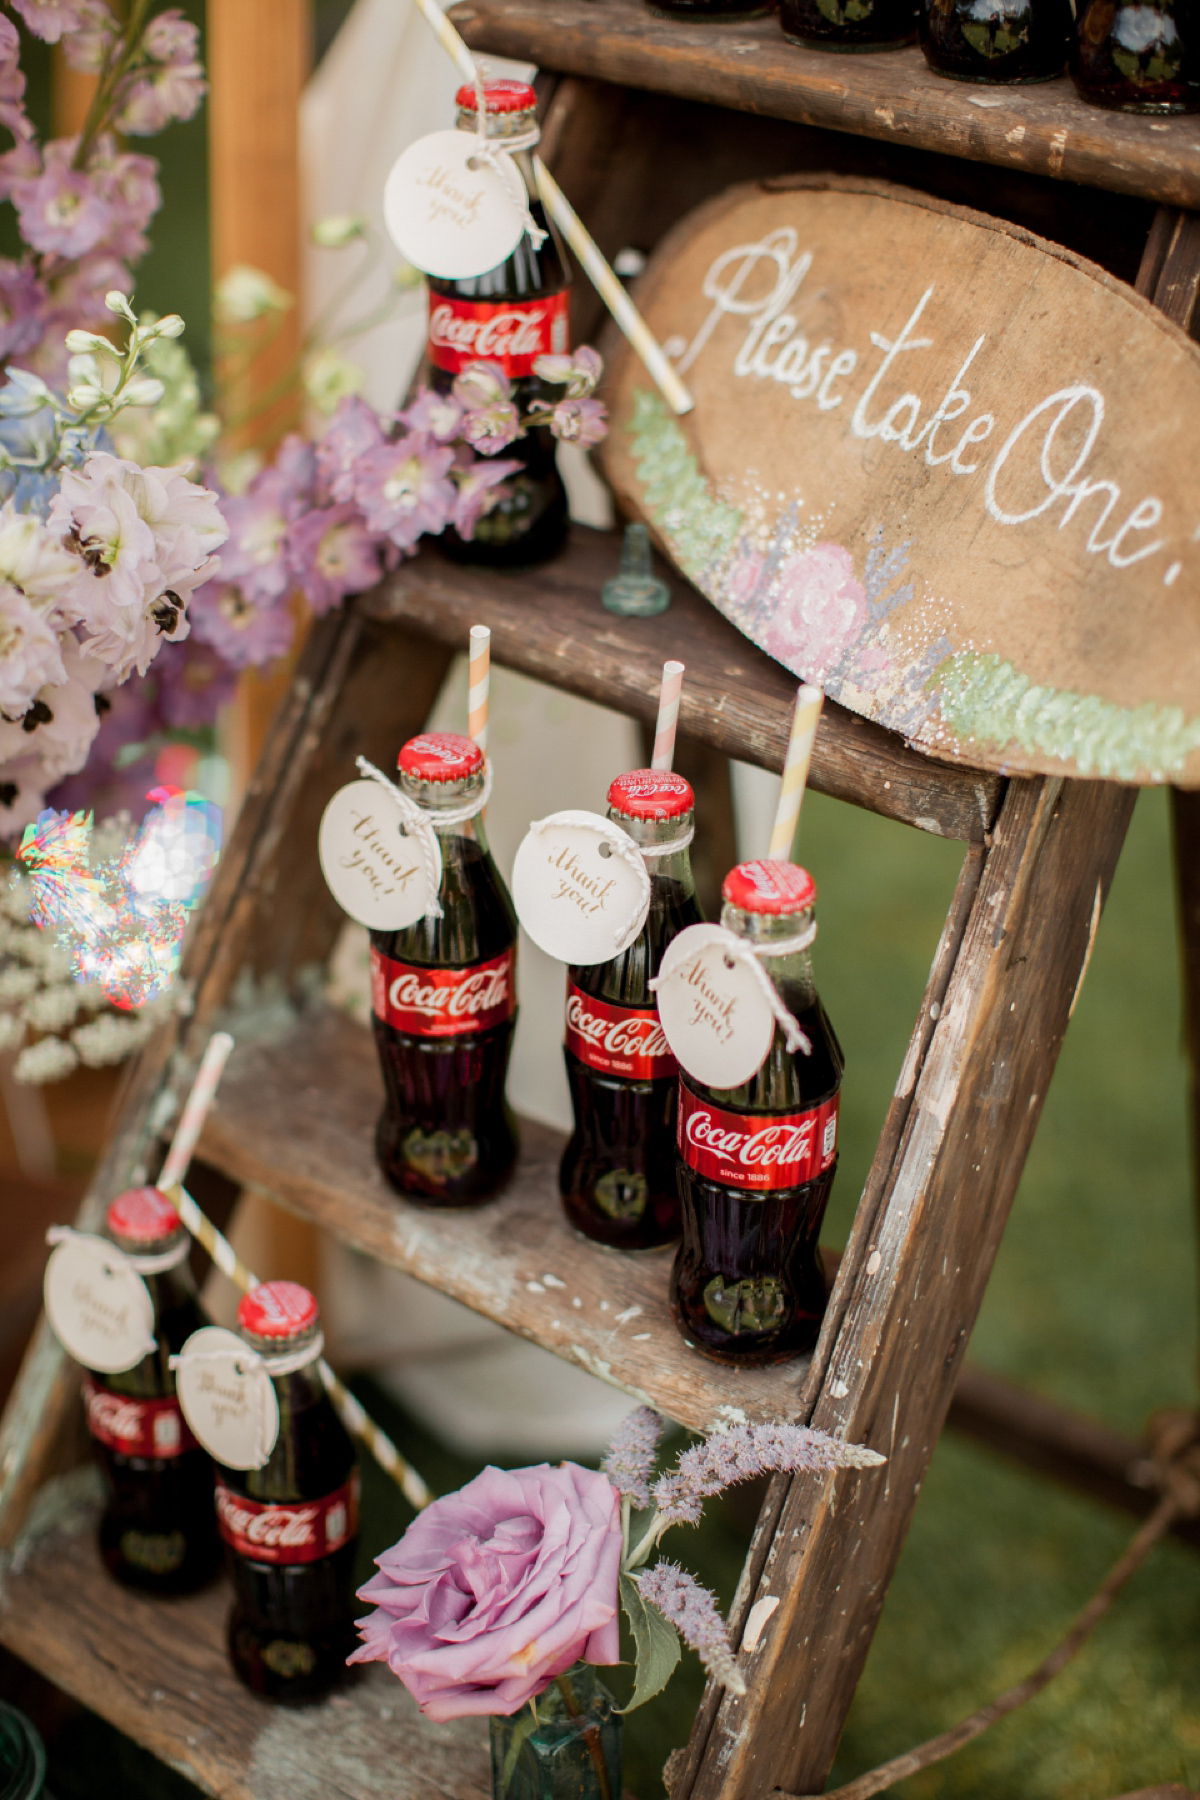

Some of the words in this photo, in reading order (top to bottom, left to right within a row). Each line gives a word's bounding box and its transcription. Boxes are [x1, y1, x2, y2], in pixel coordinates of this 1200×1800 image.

[430, 304, 547, 356] Coca-Cola
[662, 226, 857, 411] Please
[851, 284, 994, 475] take
[340, 850, 394, 902] you!
[350, 809, 421, 896] thank
[547, 845, 617, 911] thank
[551, 879, 600, 919] you!
[389, 961, 510, 1017] Coca-Cola
[680, 959, 738, 1031] thank
[566, 995, 673, 1057] Coca-Cola
[688, 998, 734, 1045] you!
[686, 1111, 817, 1166] Coca-Cola
[720, 1168, 745, 1181] since
[747, 1173, 771, 1182] 1886
